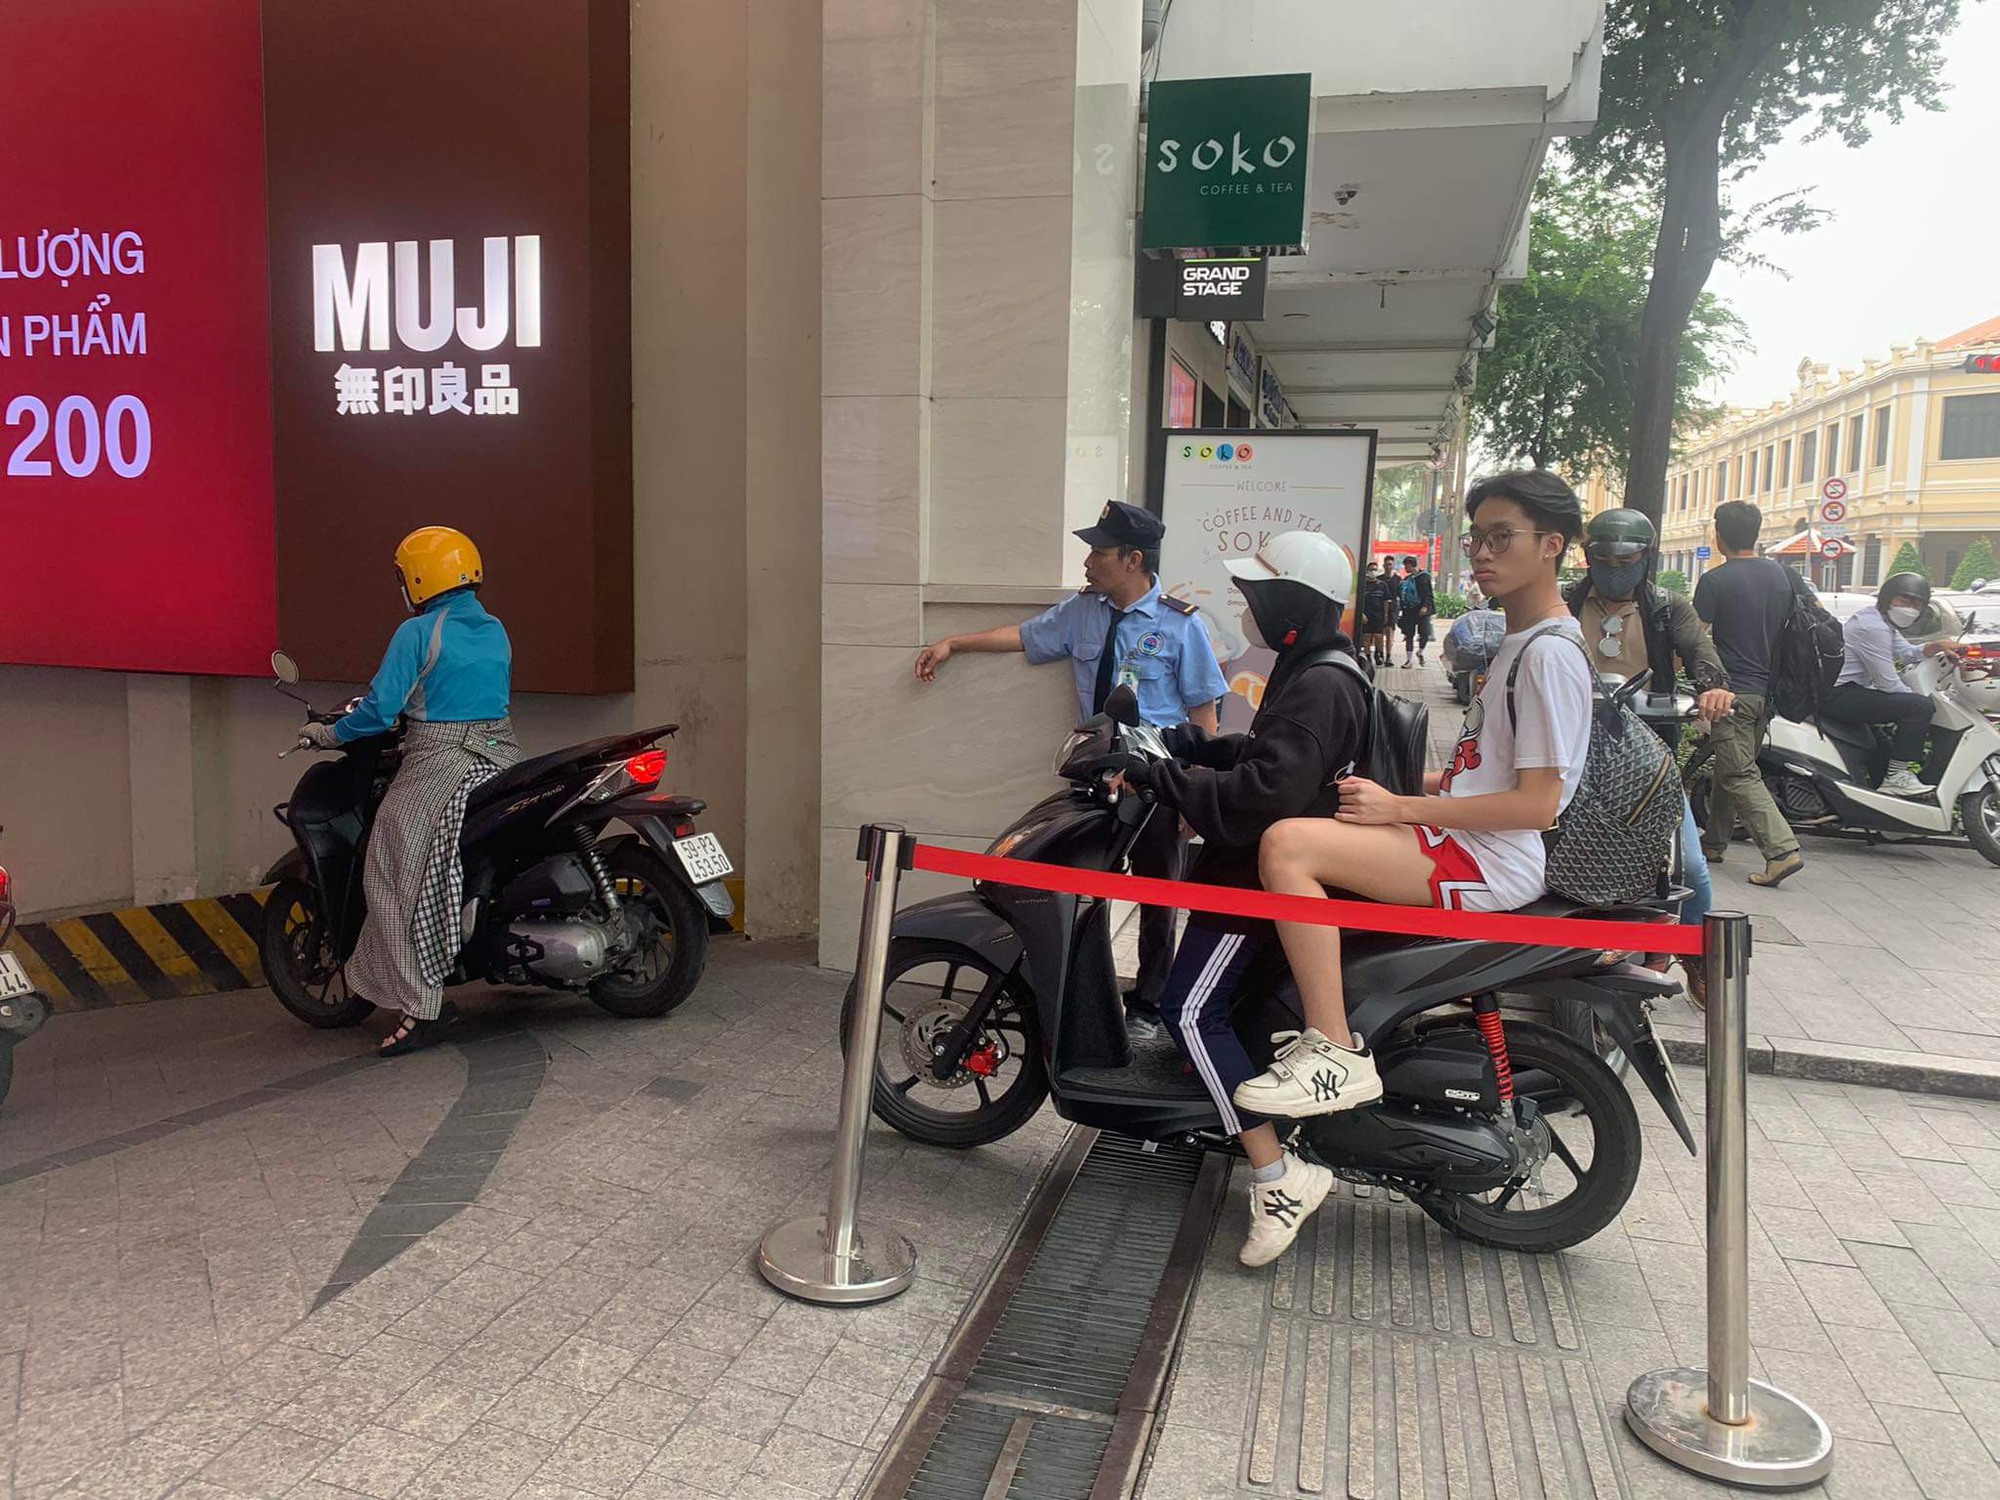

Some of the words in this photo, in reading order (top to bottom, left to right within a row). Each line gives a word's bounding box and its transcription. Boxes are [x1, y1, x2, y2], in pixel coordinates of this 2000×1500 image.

[1200, 183, 1250, 196] COFFEE
[1256, 182, 1264, 194] &
[1271, 181, 1295, 193] TEA
[1183, 266, 1250, 281] GRAND
[312, 235, 542, 352] MUJI
[1183, 281, 1242, 296] STAGE
[24, 293, 148, 357] PHẨM
[334, 361, 519, 415] 無印良品
[6, 395, 151, 479] 200
[1236, 481, 1287, 492] WELCOME
[1203, 506, 1257, 532] COFFEE
[1262, 507, 1293, 523] AND
[1298, 513, 1323, 533] TEA
[1218, 531, 1271, 552] SOK
[690, 854, 730, 879] 453.50
[0, 973, 28, 996] .44
[1311, 1068, 1340, 1103] NY
